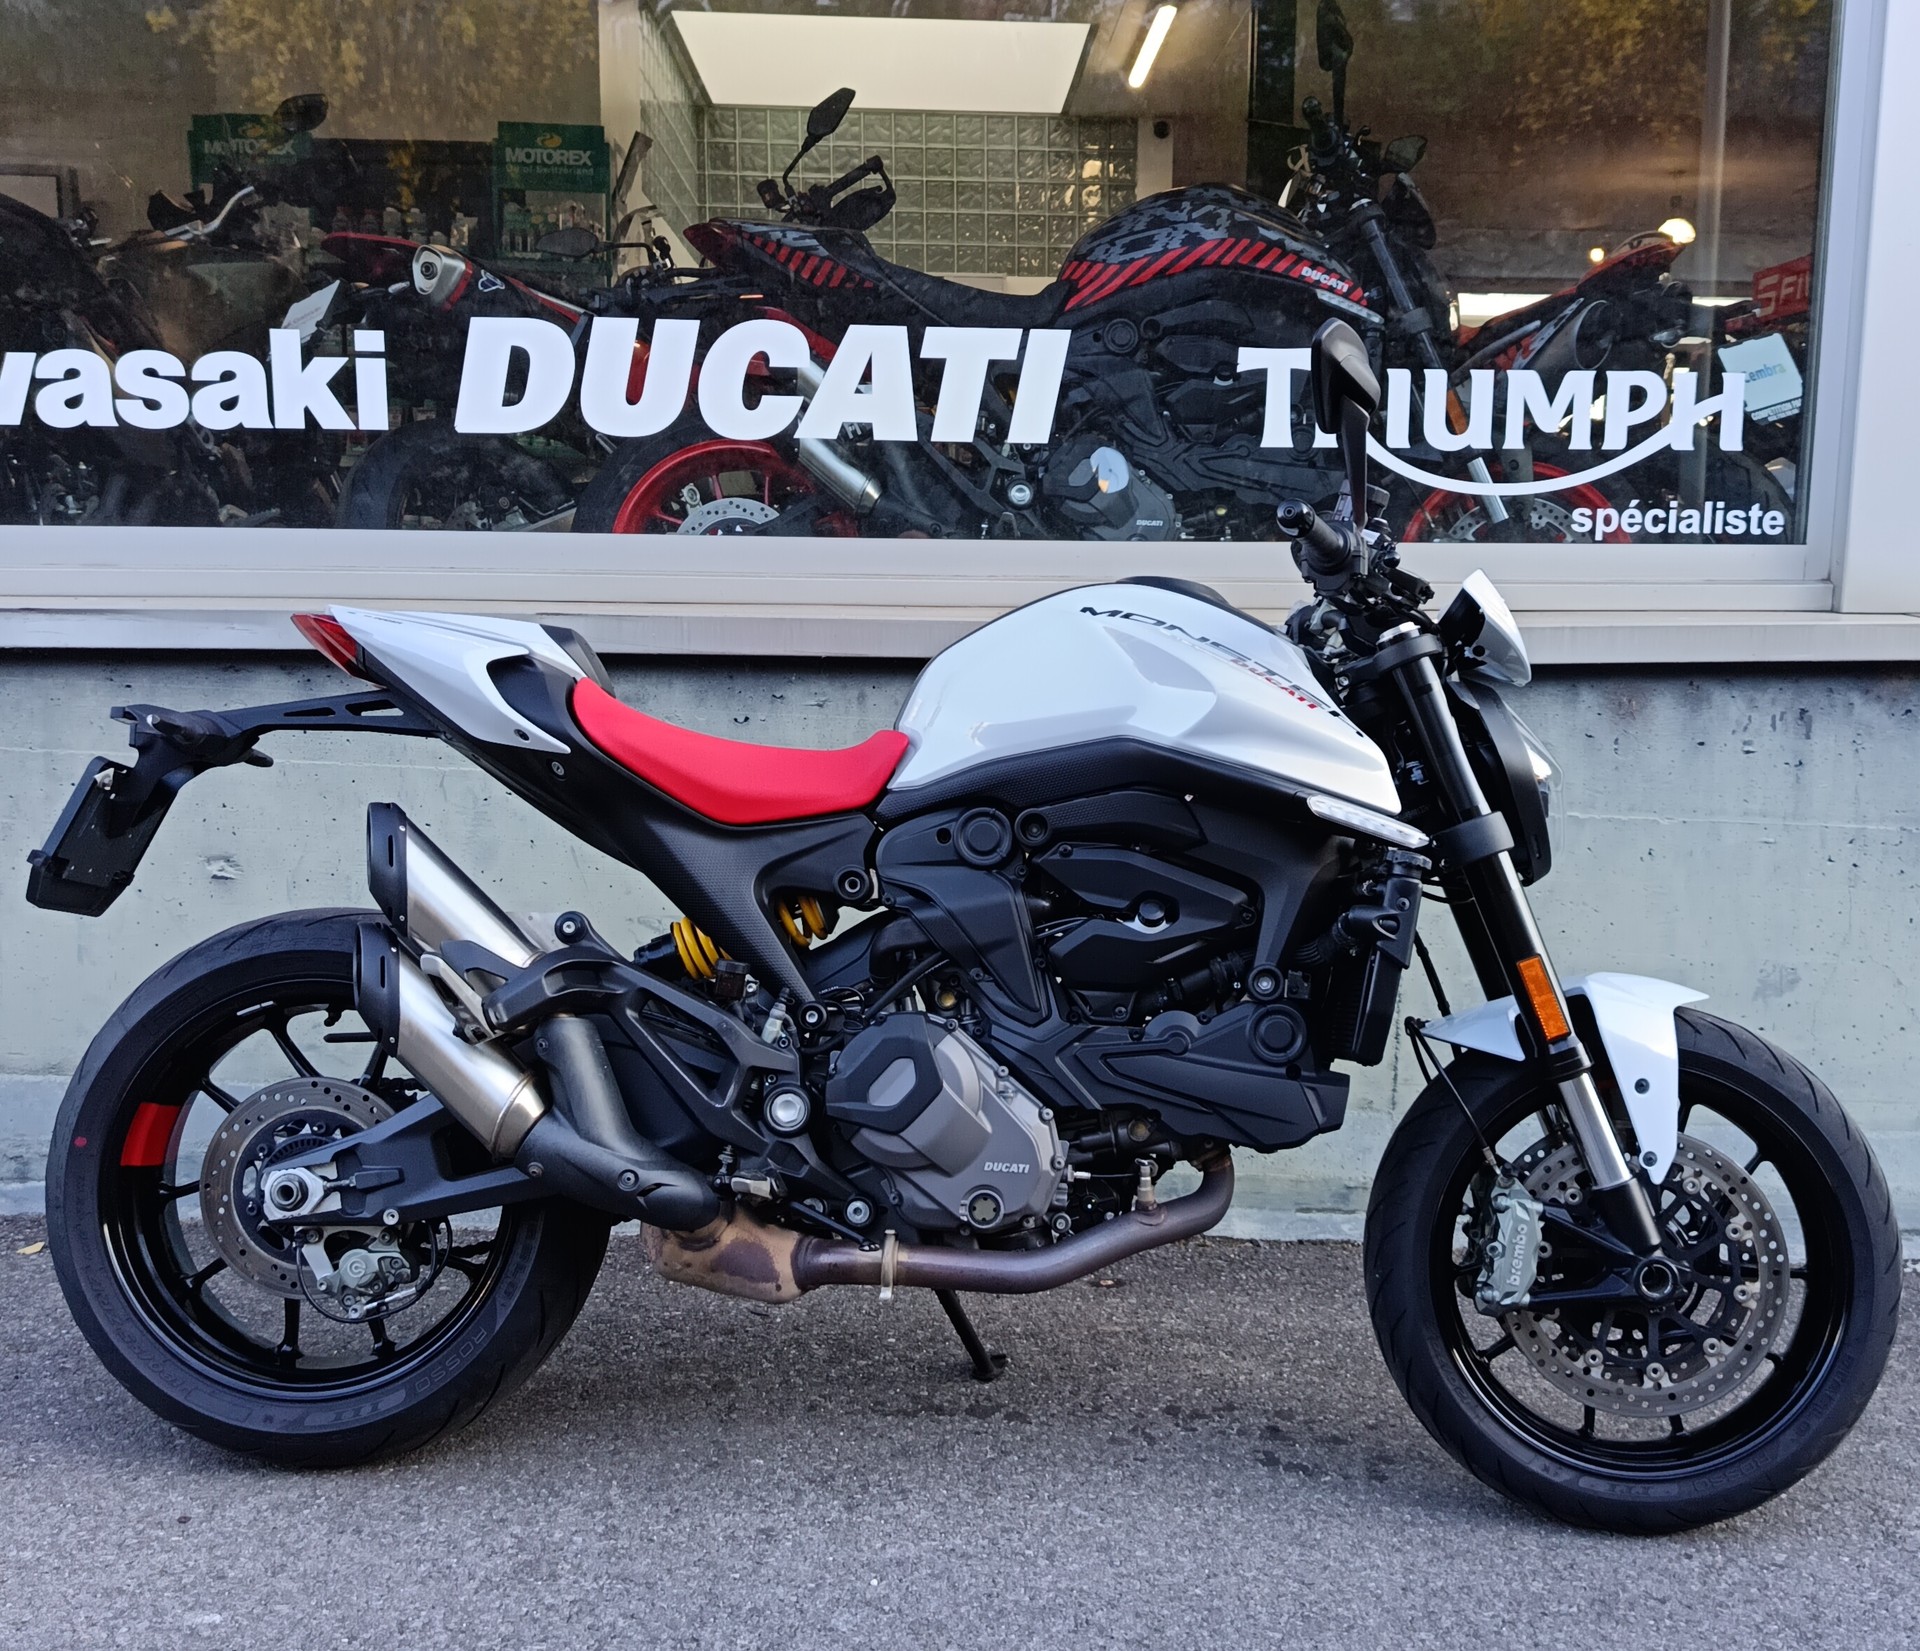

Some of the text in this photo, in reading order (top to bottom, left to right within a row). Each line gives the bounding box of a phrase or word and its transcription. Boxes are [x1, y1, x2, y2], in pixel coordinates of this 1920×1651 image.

[505, 147, 592, 166] MOTOREX
[1301, 266, 1349, 292] DUCATI
[454, 316, 1072, 444] DUCATI
[1236, 346, 1746, 452] TIUMPH
[1136, 519, 1164, 527] DUCATI
[1570, 499, 1786, 541] spécialiste
[984, 1161, 1030, 1174] DUCATI
[1506, 1223, 1528, 1287] brembo
[415, 1326, 487, 1394] ROSSO
